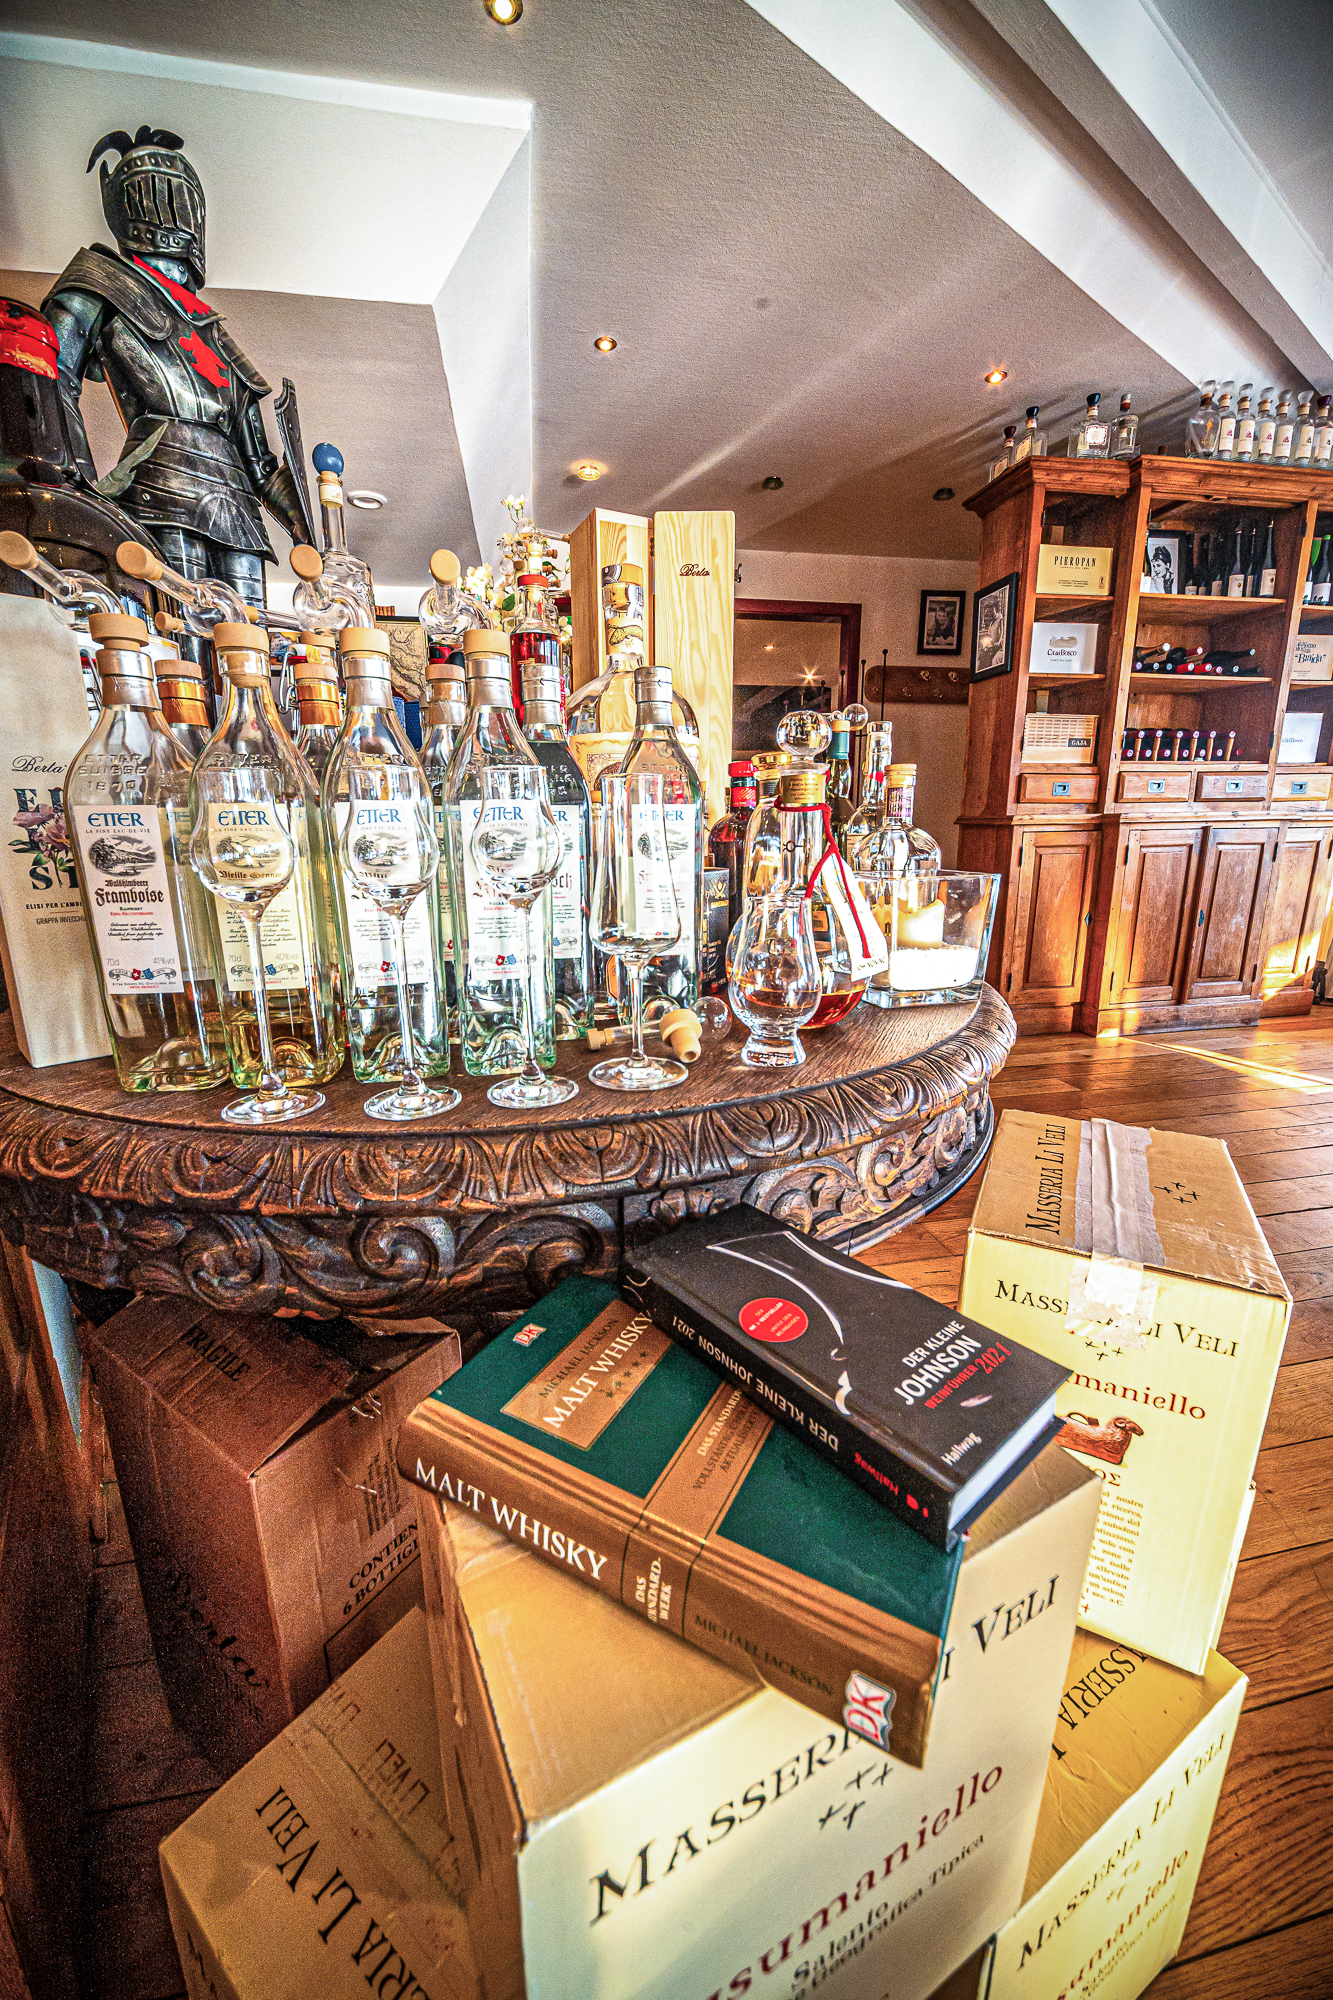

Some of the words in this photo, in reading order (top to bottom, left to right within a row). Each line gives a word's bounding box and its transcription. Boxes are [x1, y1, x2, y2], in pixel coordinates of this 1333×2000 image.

[1054, 555, 1097, 567] PIEROPAN
[12, 755, 66, 773] Berta
[88, 812, 145, 827] ETTER
[218, 810, 270, 826] ETTER
[356, 808, 402, 826] ETTER
[94, 887, 164, 906] Framboise
[1037, 1123, 1066, 1146] VELI
[1035, 1149, 1065, 1164] LI
[1025, 1167, 1064, 1235] MASSERIA
[515, 1324, 540, 1344] DK
[672, 1315, 697, 1341] 2021
[902, 1347, 931, 1368] DER
[923, 1320, 966, 1351] KLEINE
[1172, 1321, 1240, 1358] VELI
[178, 1324, 251, 1383] FRAGILE
[542, 1373, 598, 1429] MALT
[589, 1312, 653, 1372] WHISKY
[697, 1335, 754, 1384] JOHNSON
[893, 1334, 982, 1406] JOHNSON
[974, 1341, 1012, 1375] 2021
[538, 1355, 582, 1398] MICHAEL
[1065, 1372, 1206, 1420] maniello
[755, 1378, 806, 1425] KLEINE
[696, 1437, 714, 1456] DAS
[808, 1417, 839, 1452] DER
[940, 1432, 983, 1467] Hallwag
[415, 1457, 486, 1512] MALT
[490, 1496, 608, 1580] WHISKY
[349, 1519, 420, 1590] CONTIEN
[343, 1601, 353, 1616] 6
[695, 1614, 758, 1656] MICHAEL
[846, 1677, 886, 1744] DK
[589, 1727, 864, 1928] MASSERI
[971, 1573, 1060, 1654] VELI
[255, 1784, 321, 1893] VELI
[1017, 1824, 1143, 1973] MASSERIA
[1150, 1786, 1176, 1827] LI
[1183, 1731, 1227, 1787] VELI
[928, 1834, 985, 1886] Tipica
[793, 1901, 889, 1981] Salento
